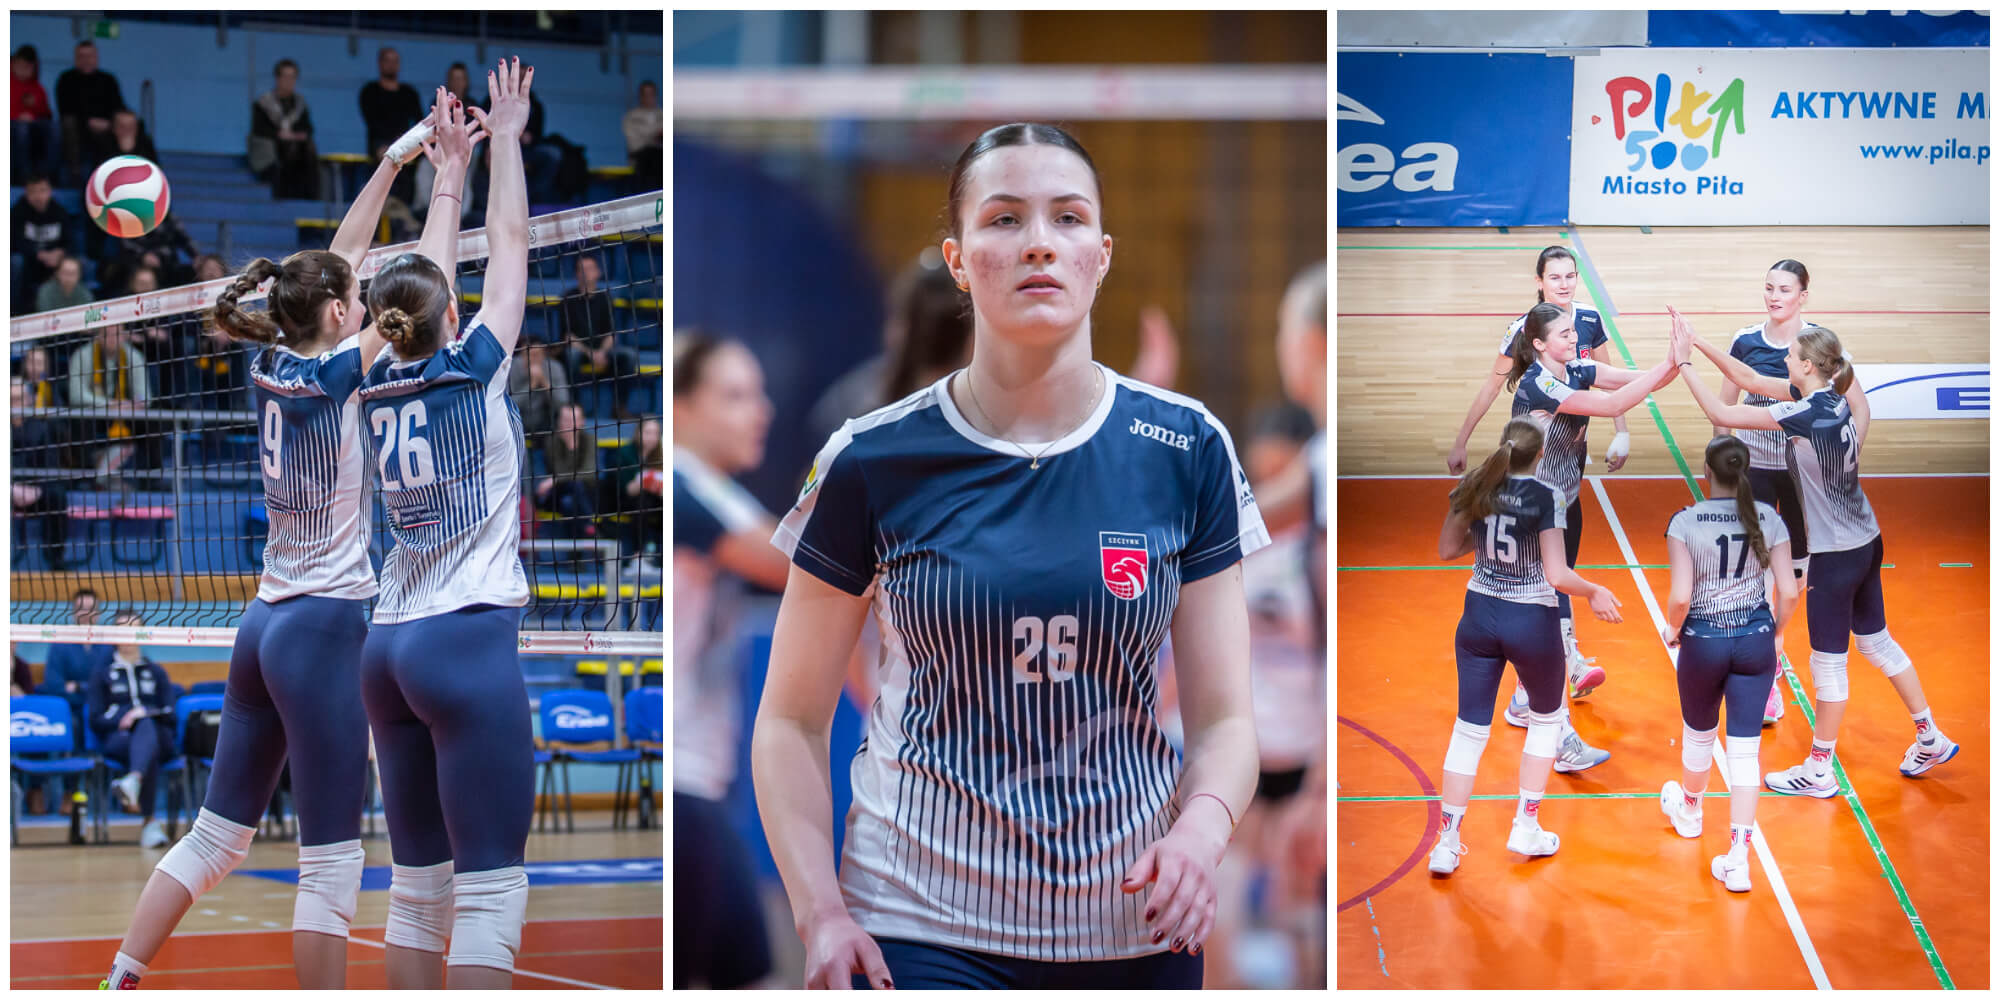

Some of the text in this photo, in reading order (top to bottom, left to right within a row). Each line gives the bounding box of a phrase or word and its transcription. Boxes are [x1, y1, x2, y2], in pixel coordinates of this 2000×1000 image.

[1770, 91, 1990, 119] AKTYWNE M
[1625, 130, 1709, 172] 500
[1860, 138, 1990, 165] www.pila.p
[1602, 175, 1744, 195] Miasto Piła
[263, 399, 283, 480] 9
[371, 399, 435, 490] 26
[1484, 514, 1517, 563] 15
[1715, 533, 1750, 579] 17
[1014, 614, 1079, 684] 26
